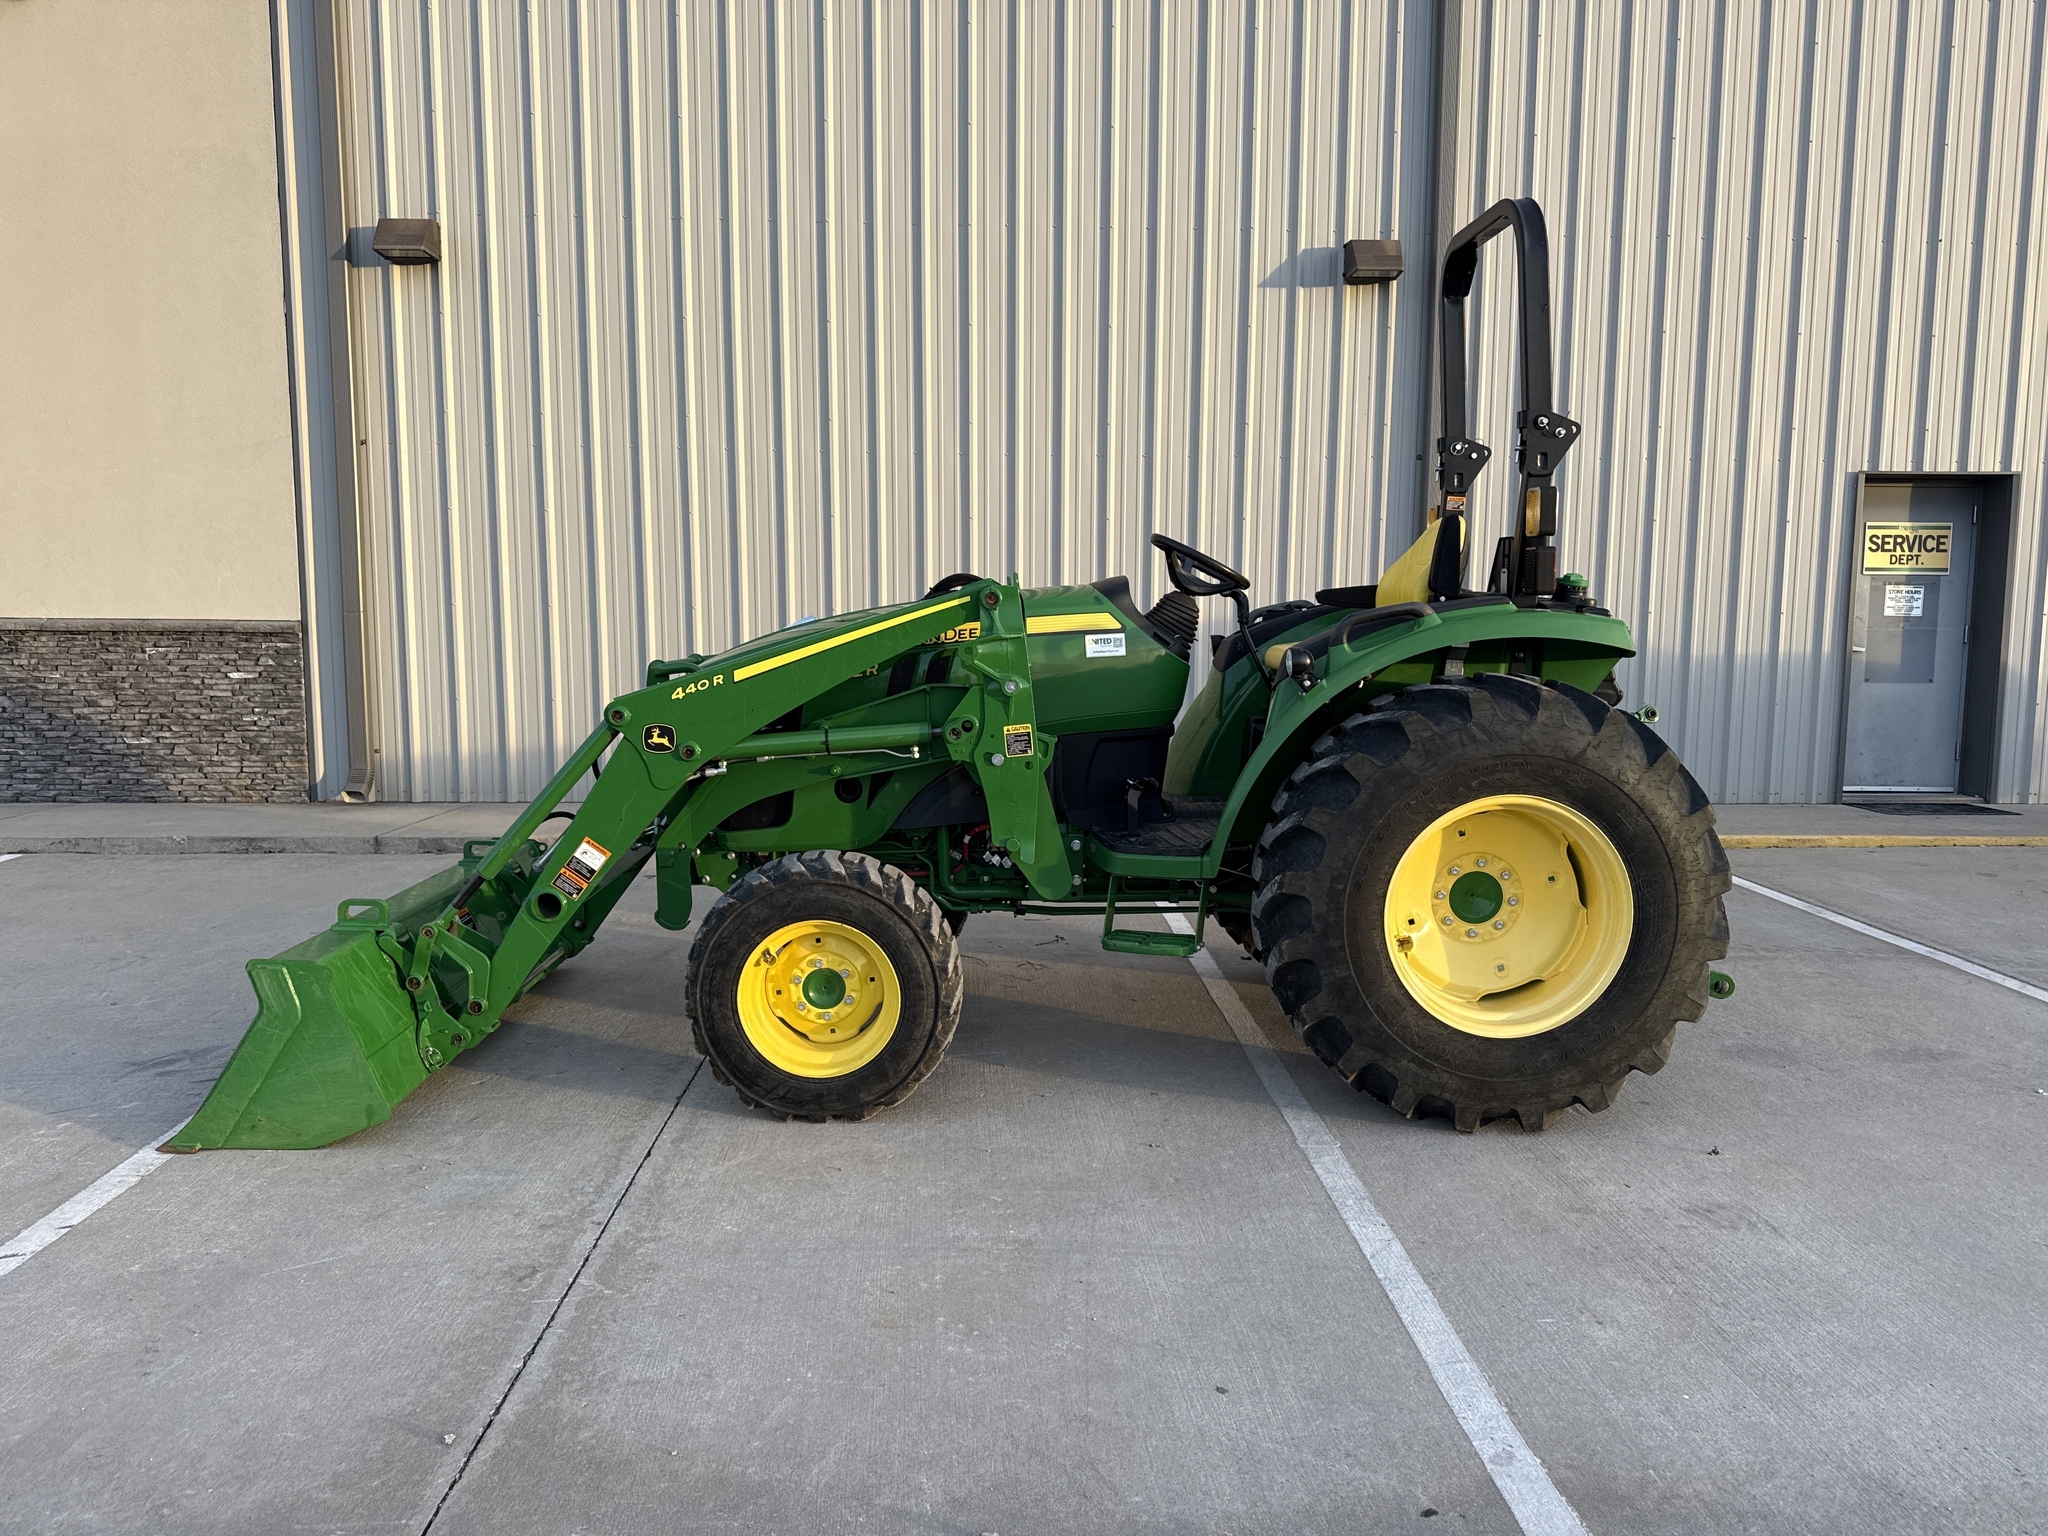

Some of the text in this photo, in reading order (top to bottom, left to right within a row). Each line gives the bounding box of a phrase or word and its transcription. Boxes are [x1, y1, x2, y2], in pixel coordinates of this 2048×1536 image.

[1868, 534, 1949, 553] SERVICE
[1889, 554, 1924, 565] DEPT.
[944, 627, 979, 641] DEE
[671, 679, 710, 700] 440
